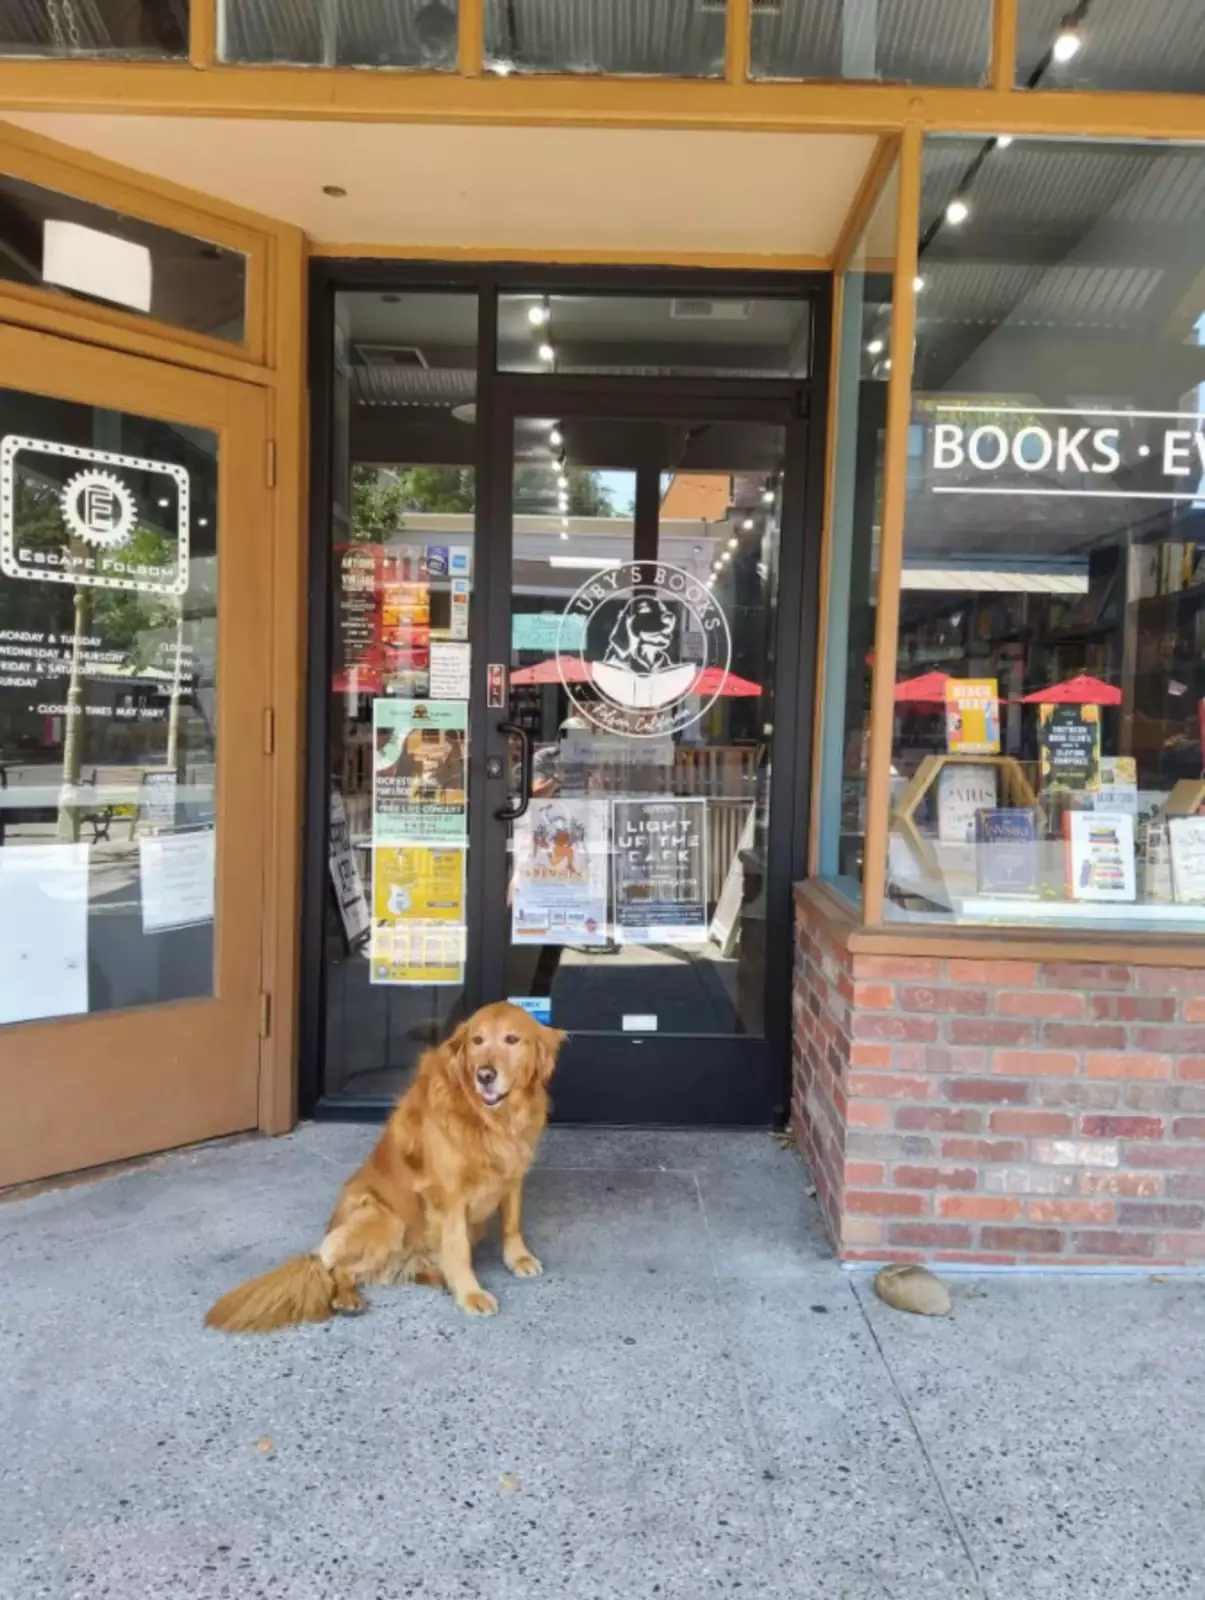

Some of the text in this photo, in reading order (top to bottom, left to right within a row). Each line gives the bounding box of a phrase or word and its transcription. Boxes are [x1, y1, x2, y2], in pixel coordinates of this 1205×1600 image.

[933, 424, 1121, 474] BOOKS
[19, 548, 95, 569] ESCAPE
[653, 567, 720, 631] BOOKS
[626, 820, 692, 833] LIGHT
[657, 834, 700, 847] THE
